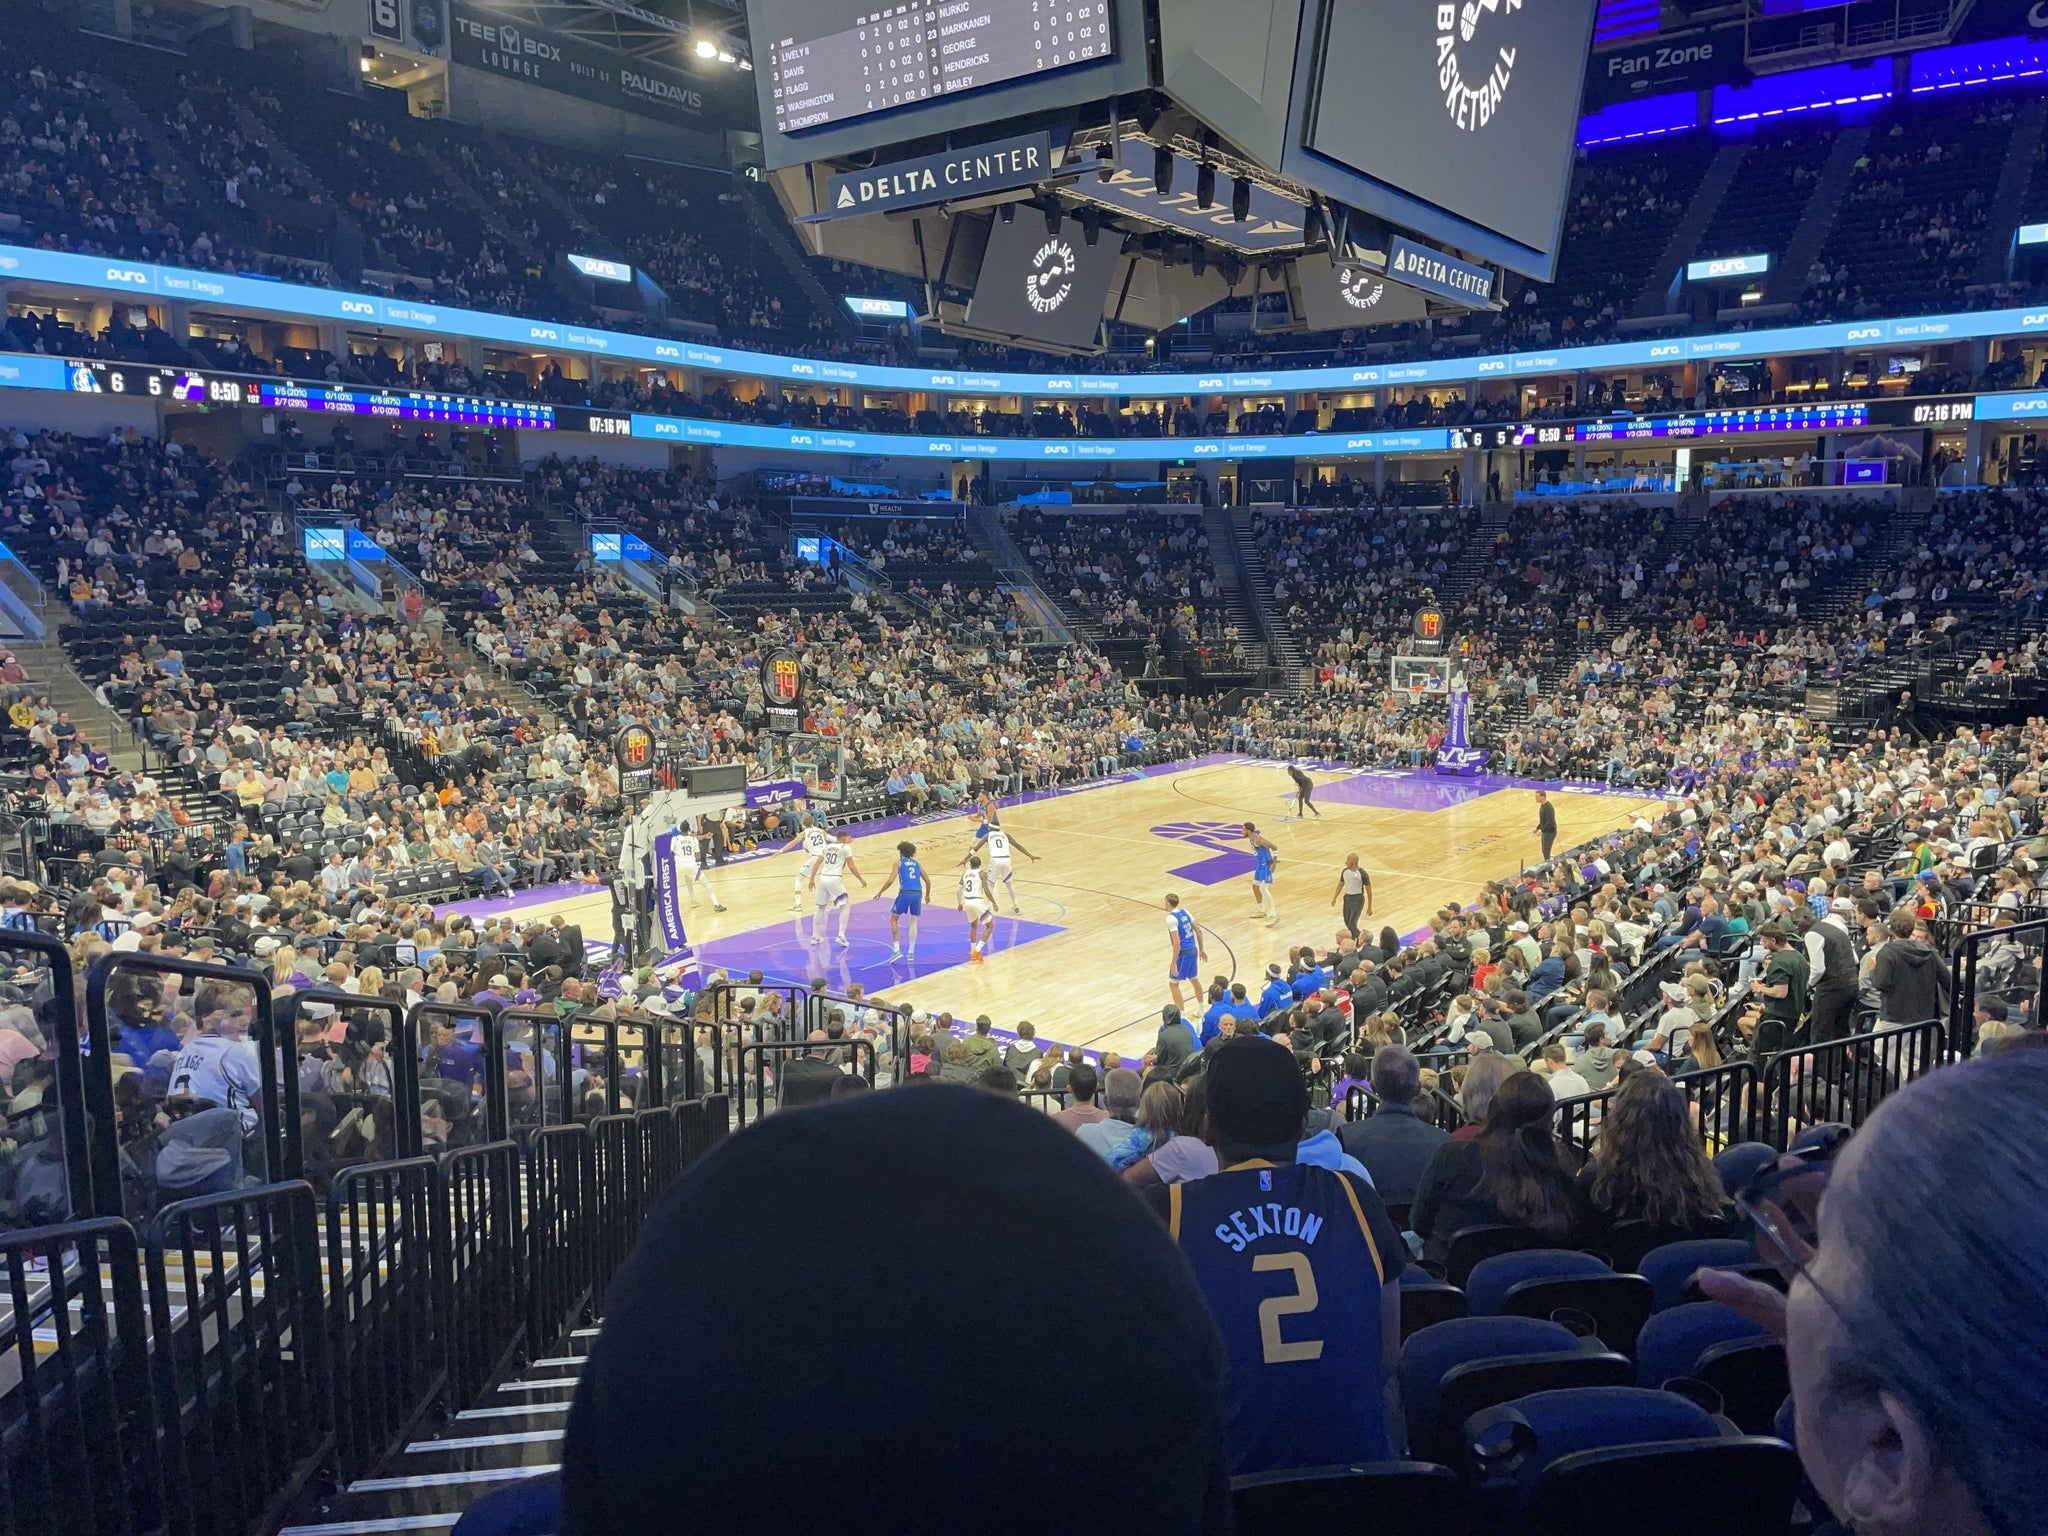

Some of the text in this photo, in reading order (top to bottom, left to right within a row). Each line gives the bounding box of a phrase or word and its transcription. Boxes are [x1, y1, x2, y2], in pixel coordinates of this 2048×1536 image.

[925, 1, 970, 22] 30 NURKIC
[927, 1, 1039, 40] 23 MARKKANEN 2
[455, 17, 561, 62] TEE BOX
[771, 56, 777, 65] 2
[782, 47, 804, 62] LIVELY
[859, 31, 866, 41] 0
[874, 27, 880, 37] 2
[886, 24, 893, 33] 0
[898, 19, 909, 31] 02
[913, 16, 920, 26] 0
[931, 3, 1104, 58] 3 GEORGE 0 0 0 02 0
[482, 48, 540, 79] LOUNGE
[774, 34, 922, 81] 3 DAVIS 0 0 0 02 0
[932, 23, 1105, 76] 0 HENDRICKS 0 0 0 02 0
[1608, 43, 1713, 78] Fan Zone
[570, 61, 595, 78] BUILT
[773, 51, 923, 98] 32 FLAGG 2 1 0 02 0
[933, 42, 1107, 94] 19 BAILEY 3 0 0 02 2
[1437, 4, 1516, 131] BASKETBALL
[621, 69, 702, 108] PAUDAVIS
[776, 69, 925, 115] 25 WASHINGTON 0 2 0 02 0
[778, 87, 927, 131] 31 THOMPSON 4 1 0 02 0
[859, 147, 1040, 202] DELTA CENTER
[1032, 239, 1075, 274] UTAH JAZZ
[1341, 269, 1352, 284] UTA
[1408, 253, 1490, 298] DELTA CENTER
[1026, 273, 1072, 313] BASKETBALL
[1341, 283, 1384, 309] BASKETBALL
[111, 373, 259, 402] 6 5 8:50 14
[246, 394, 260, 404] 1ST
[274, 387, 286, 396] 1/5
[287, 388, 308, 398] (20%)
[325, 391, 338, 400] 0/1
[274, 397, 287, 406] 2/7
[288, 398, 308, 409] (29%)
[324, 402, 335, 410] 1/3
[336, 402, 355, 412] (33%)
[1914, 403, 1973, 422] 07:16 PM
[589, 416, 631, 435] 07:16 PM
[1474, 433, 1482, 446] 6
[1497, 431, 1506, 444] 5
[1539, 428, 1560, 442] 8:50
[776, 660, 797, 674] 8:50
[780, 674, 795, 697] 14
[628, 736, 648, 748] 8:50
[632, 747, 644, 762] 14
[682, 845, 693, 856] 19
[810, 834, 824, 846] 23
[996, 838, 1003, 849] 0
[824, 853, 838, 864] 30
[909, 867, 916, 879] 2
[662, 857, 679, 940] AMERICA FIRST
[966, 879, 973, 892] 3
[1215, 1203, 1324, 1252] SEXTON
[1252, 1251, 1324, 1364] 2
